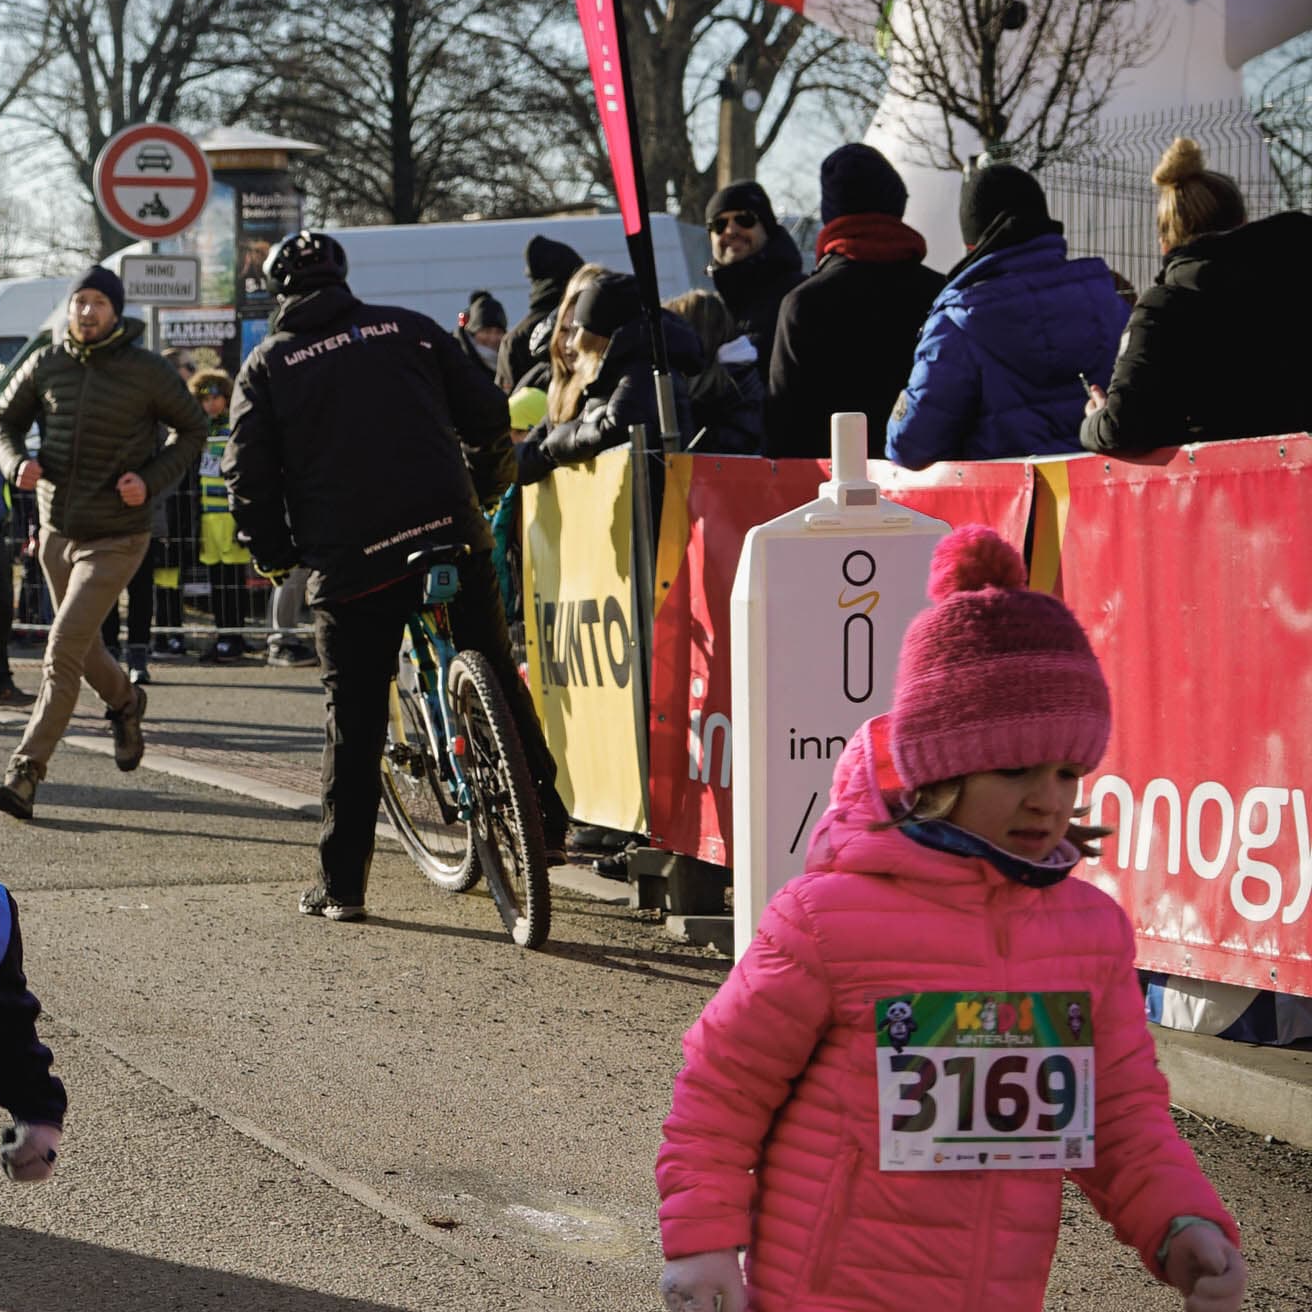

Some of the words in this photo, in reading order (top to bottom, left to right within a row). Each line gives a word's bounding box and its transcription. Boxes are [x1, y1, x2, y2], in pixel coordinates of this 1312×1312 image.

[284, 332, 351, 366] WINTER
[360, 322, 399, 339] RUN
[363, 515, 453, 555] www.winter-run.cz
[790, 728, 847, 760] inn
[889, 1054, 1076, 1132] 3169
